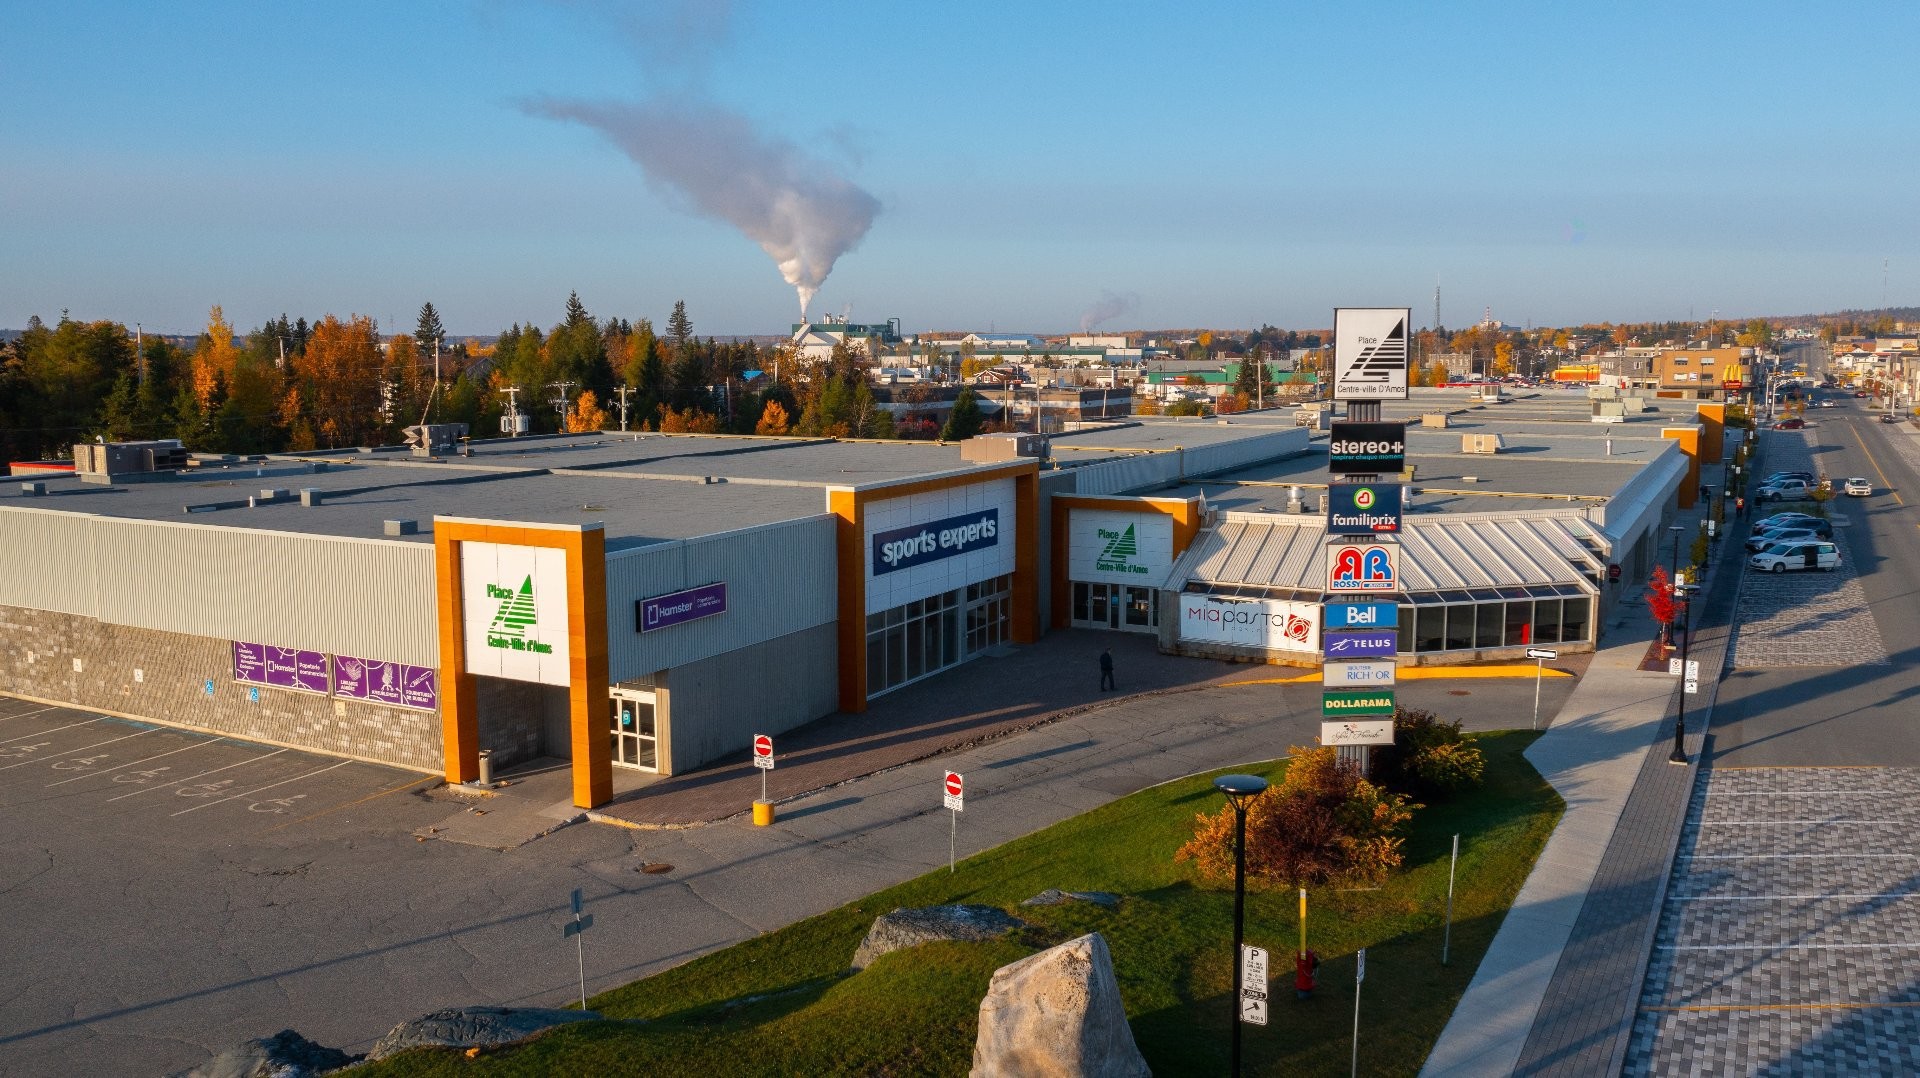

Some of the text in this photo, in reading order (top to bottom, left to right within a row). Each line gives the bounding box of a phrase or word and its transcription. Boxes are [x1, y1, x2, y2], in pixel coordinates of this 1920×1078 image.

[1358, 336, 1377, 344] Place
[1332, 513, 1396, 529] familiprix
[1098, 529, 1119, 539] Place
[882, 516, 996, 566] sports experts
[487, 584, 513, 599] Place
[659, 602, 692, 618] Hamster
[1347, 606, 1376, 624] Bell
[1353, 639, 1391, 648] TELUS
[1325, 698, 1392, 708] DOLLARAMA
[1251, 949, 1259, 960] P
